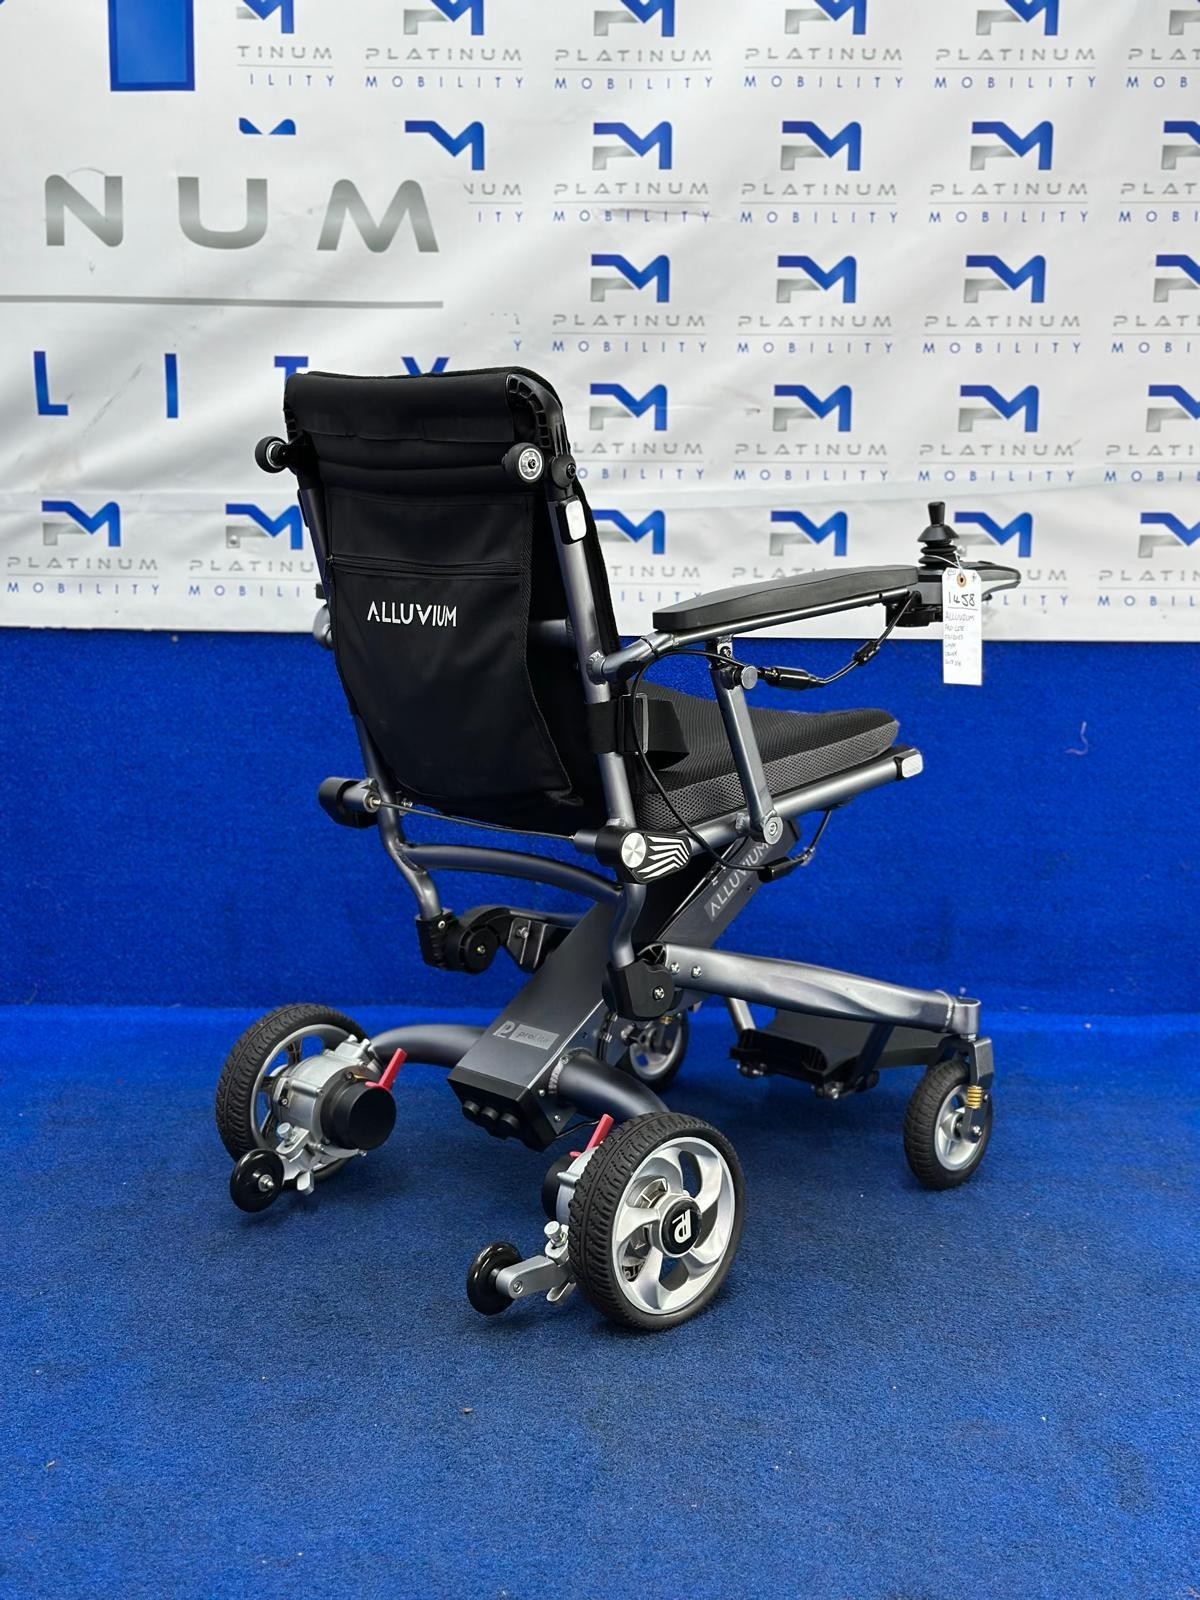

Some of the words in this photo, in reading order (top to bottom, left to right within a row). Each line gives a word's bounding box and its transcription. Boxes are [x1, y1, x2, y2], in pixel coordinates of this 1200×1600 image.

[365, 47, 522, 62] PLATINUM
[554, 48, 712, 63] PLATINUM
[744, 47, 903, 61] PLATINUM
[935, 48, 1096, 61] PLATINUM
[364, 75, 524, 89] MOBILITY
[554, 76, 713, 90] MOBILITY
[743, 74, 904, 89] MOBILITY
[933, 75, 1097, 89] MOBILITY
[1125, 75, 1188, 89] MOB
[553, 181, 709, 196] PLATINUM
[741, 182, 897, 196] PLATINUM
[929, 182, 1088, 196] PLATINUM
[45, 174, 439, 253] NUM
[552, 209, 713, 224] MOBILITY
[739, 210, 898, 224] MOBILITY
[928, 210, 1089, 224] MOBILITY
[552, 313, 705, 327] PLATINUM
[737, 315, 892, 328] PLATINUM
[924, 315, 1081, 328] PLATINUM
[551, 339, 707, 353] MOBILITY
[736, 341, 893, 354] MOBILITY
[922, 341, 1081, 354] MOBILITY
[734, 443, 887, 456] PLATINUM
[919, 443, 1074, 457] PLATINUM
[733, 468, 889, 481] MOBILITY
[917, 469, 1075, 483] MOBILITY
[7, 556, 158, 571] PLATINUM
[6, 581, 160, 595] MOBILITY
[948, 591, 976, 607] 1458
[367, 601, 457, 627] ALLUVIUM
